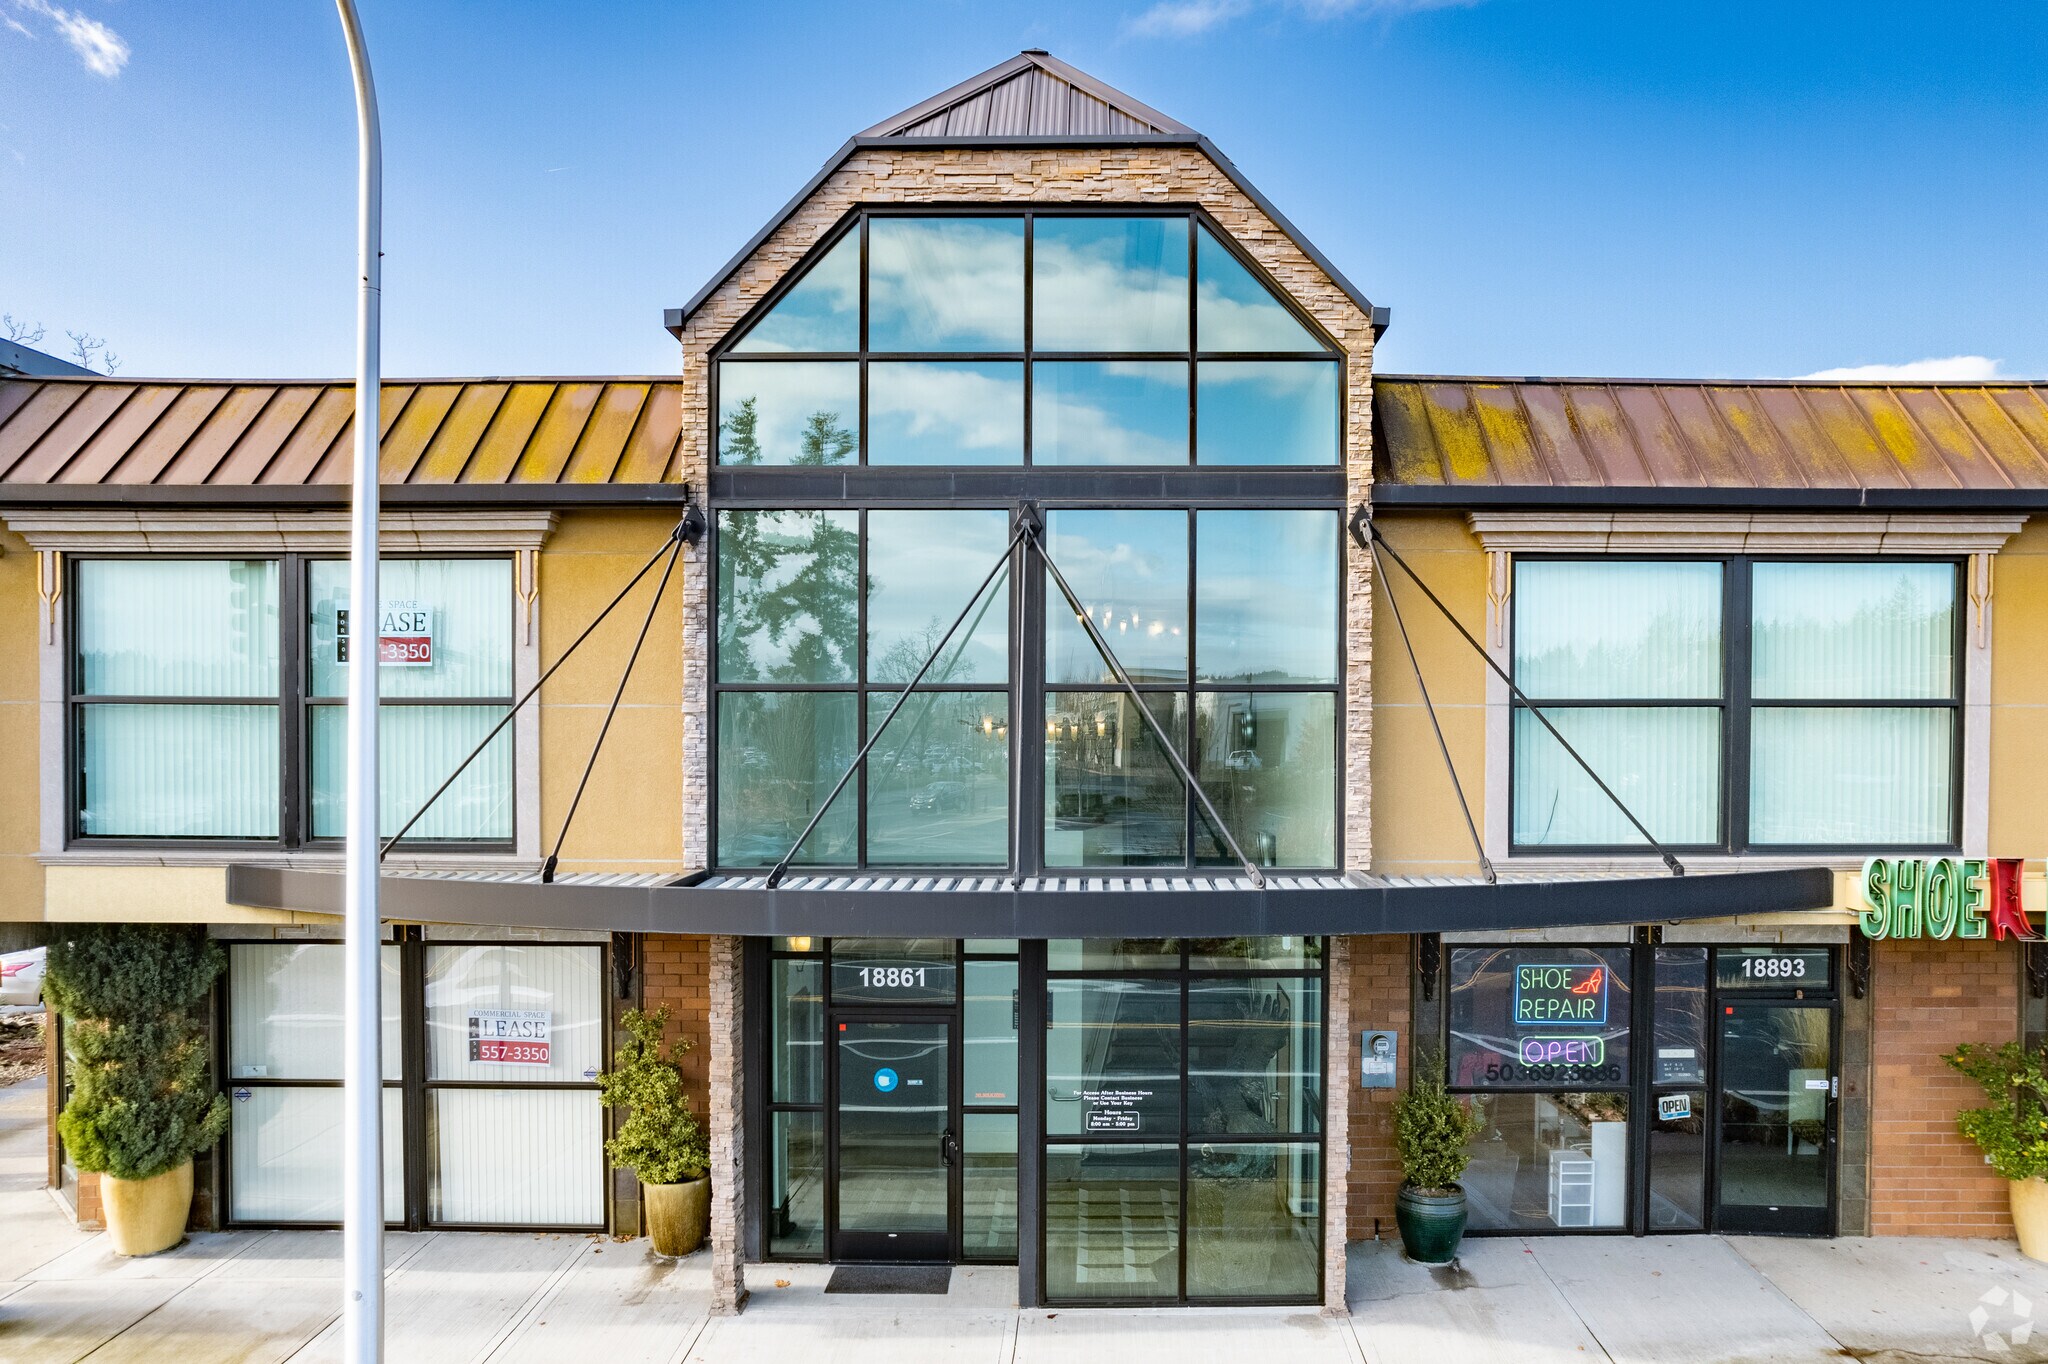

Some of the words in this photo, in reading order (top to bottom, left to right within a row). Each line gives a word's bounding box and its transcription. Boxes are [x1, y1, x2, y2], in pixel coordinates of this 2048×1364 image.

[388, 600, 418, 609] SPACE
[379, 611, 426, 632] ASE
[379, 643, 429, 660] -3350
[1859, 857, 1987, 941] SHOE
[859, 967, 925, 987] 18861
[1742, 958, 1805, 978] 18893
[1520, 968, 1572, 990] SHOE
[473, 1009, 521, 1018] COMMERCIAL
[524, 1011, 546, 1019] SPACE
[1519, 998, 1596, 1019] REPAIR
[483, 1020, 546, 1038] LEASE
[481, 1045, 549, 1061] 557-3350
[1525, 1041, 1597, 1063] OPEN
[1662, 1098, 1687, 1113] OPEN
